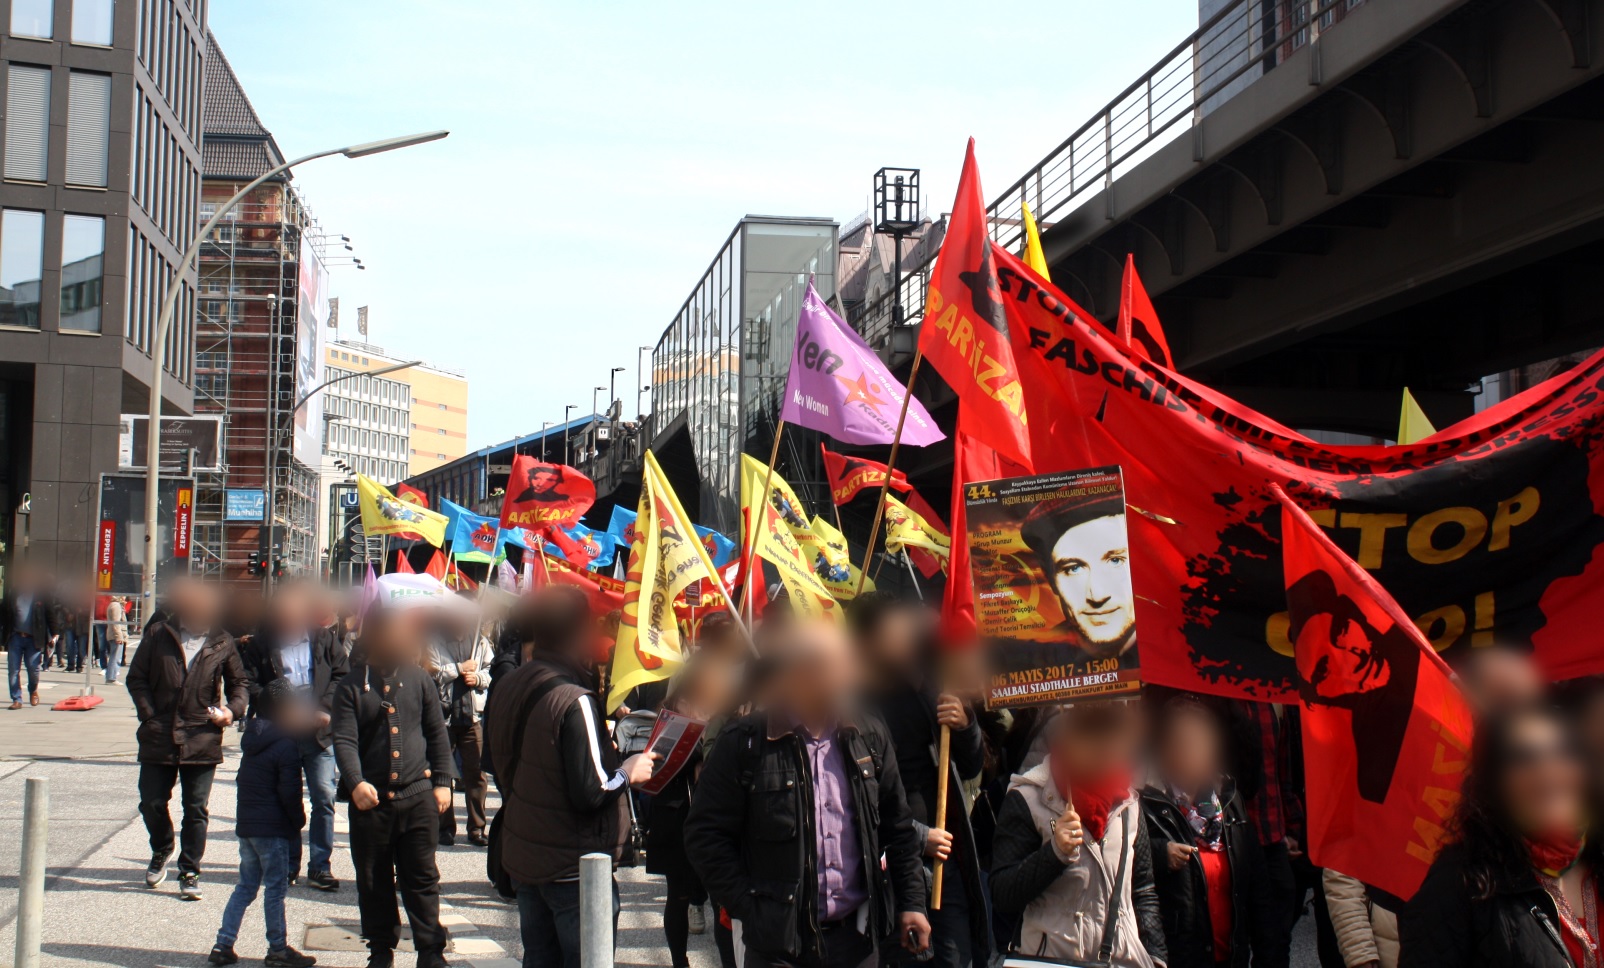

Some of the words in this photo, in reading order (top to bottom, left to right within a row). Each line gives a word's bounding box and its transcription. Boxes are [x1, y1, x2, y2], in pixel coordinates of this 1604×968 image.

[925, 285, 1028, 426] PARTİZA
[806, 393, 829, 417] Woman
[967, 485, 996, 499] 44.
[179, 513, 188, 550] ZEPPELIN
[973, 530, 1001, 539] PROGRAM
[103, 528, 112, 565] ZEPPELIN
[979, 590, 1014, 600] Sempozyum
[1009, 668, 1043, 685] MAYIS
[1045, 664, 1074, 679] 2017
[1086, 657, 1119, 674] 15:00
[991, 684, 1029, 698] SAALBAU
[1030, 677, 1081, 693] STADTHALLE
[1083, 672, 1119, 686] BERGEN
[1071, 686, 1104, 696] FRANKFURT
